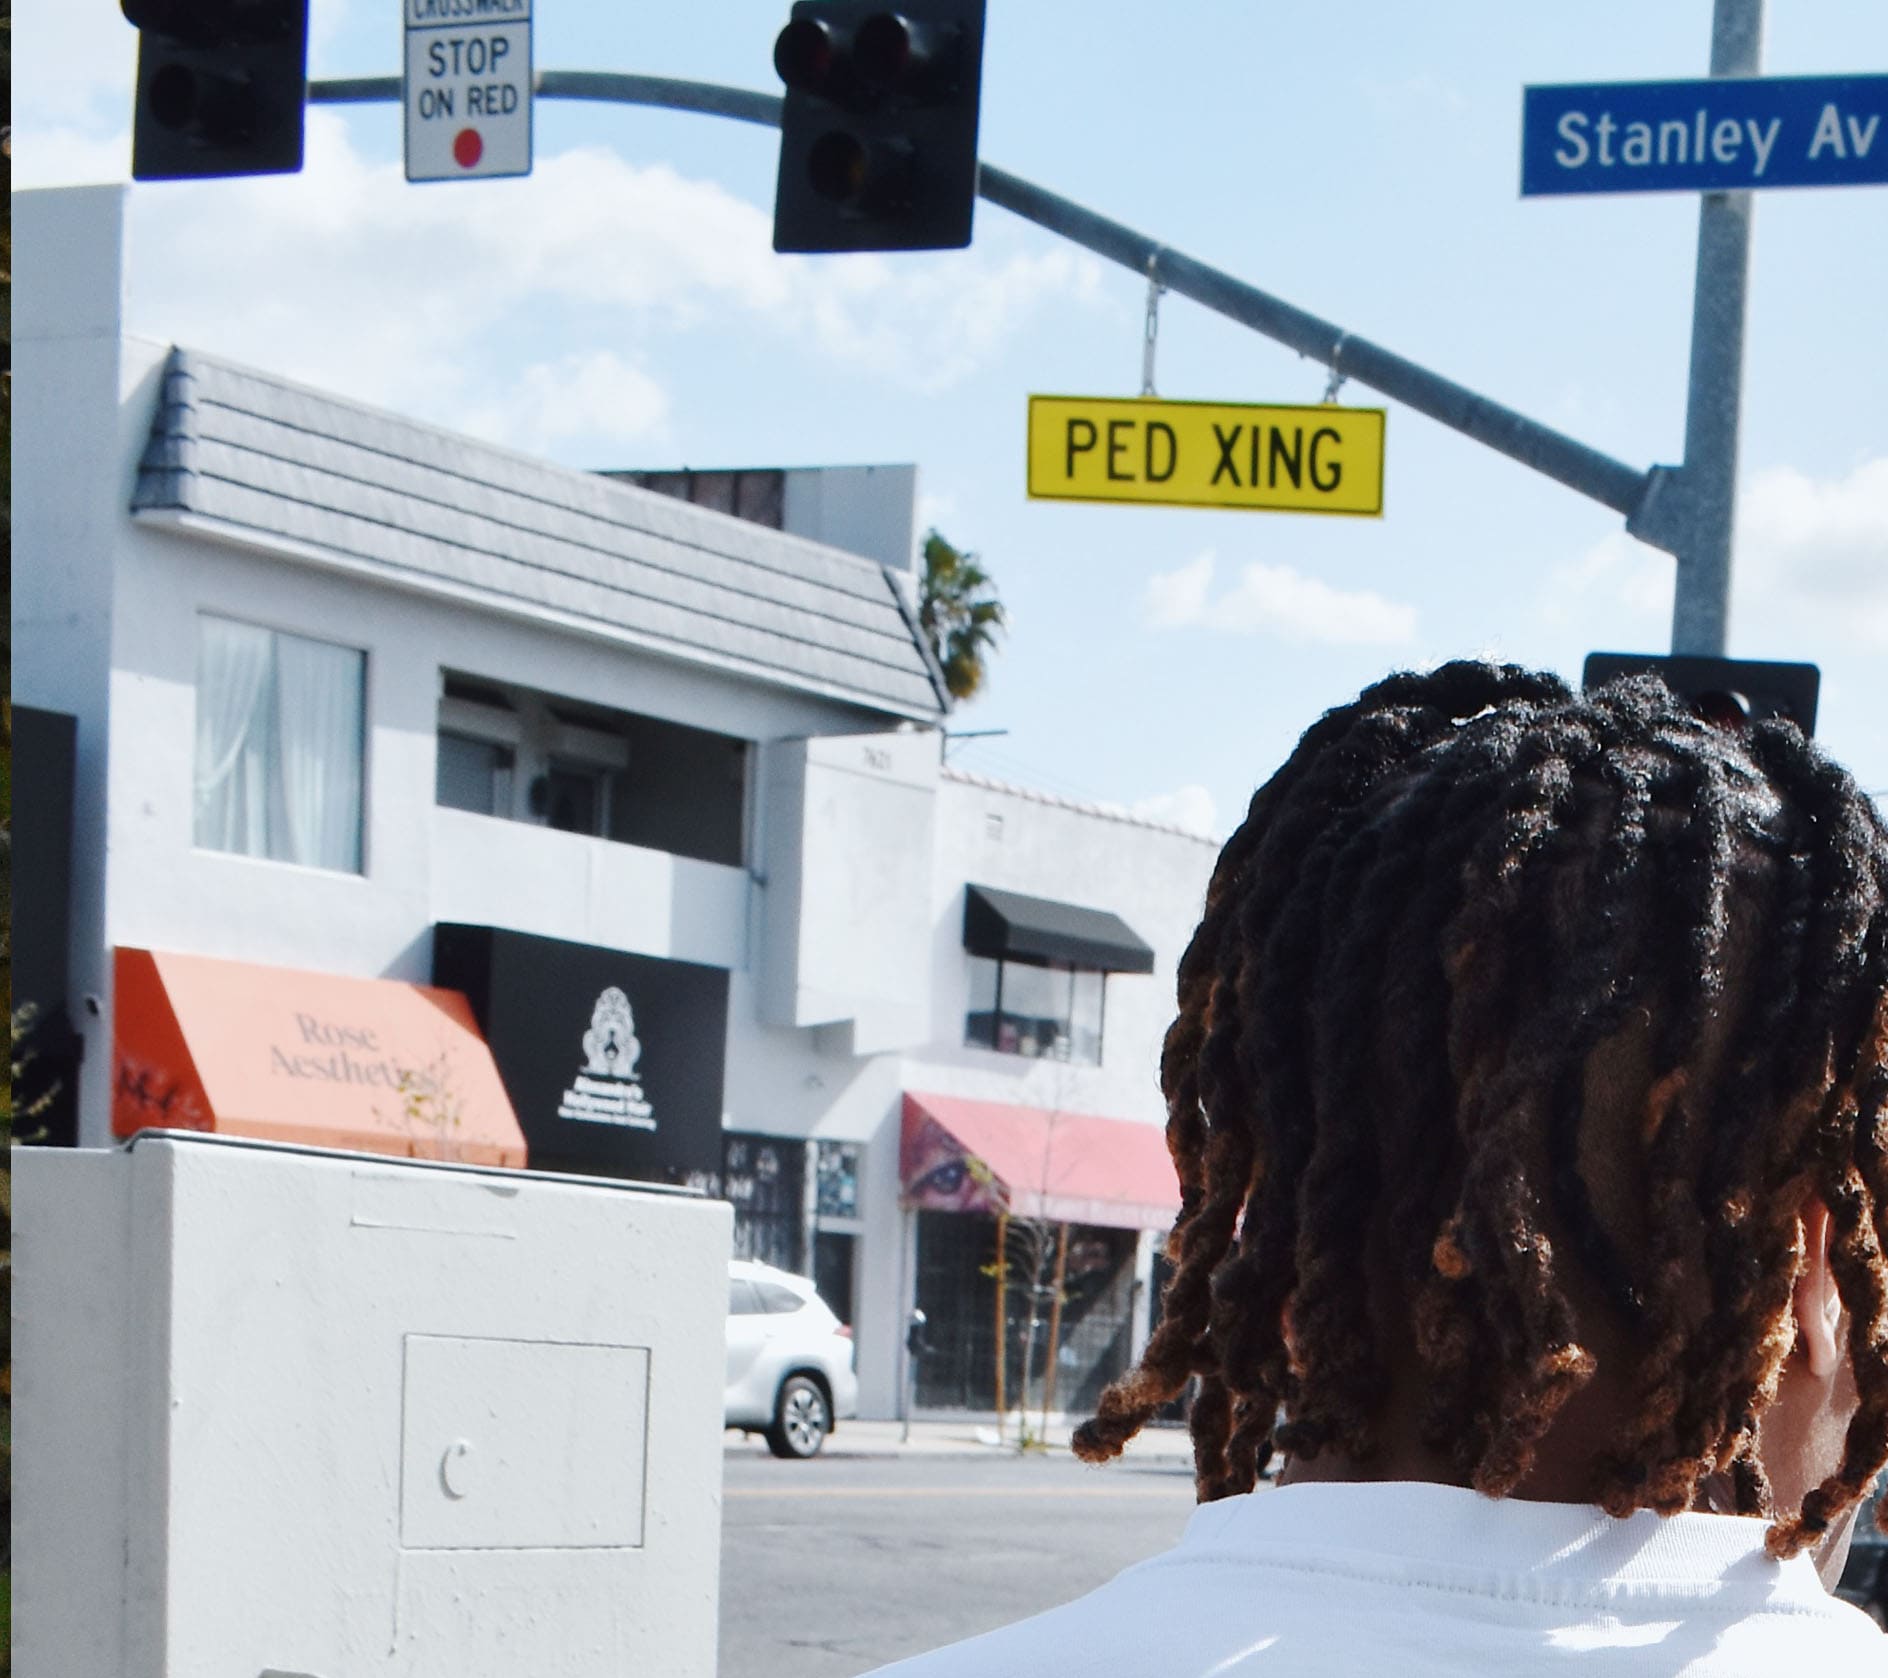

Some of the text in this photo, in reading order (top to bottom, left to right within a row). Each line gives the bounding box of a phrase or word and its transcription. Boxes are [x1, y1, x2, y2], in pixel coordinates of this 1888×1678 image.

[428, 36, 510, 78] STOP
[419, 83, 519, 119] ON RED
[1554, 103, 1881, 178] Stanley Av
[1066, 418, 1343, 493] PED XING
[295, 1011, 380, 1053] Rose
